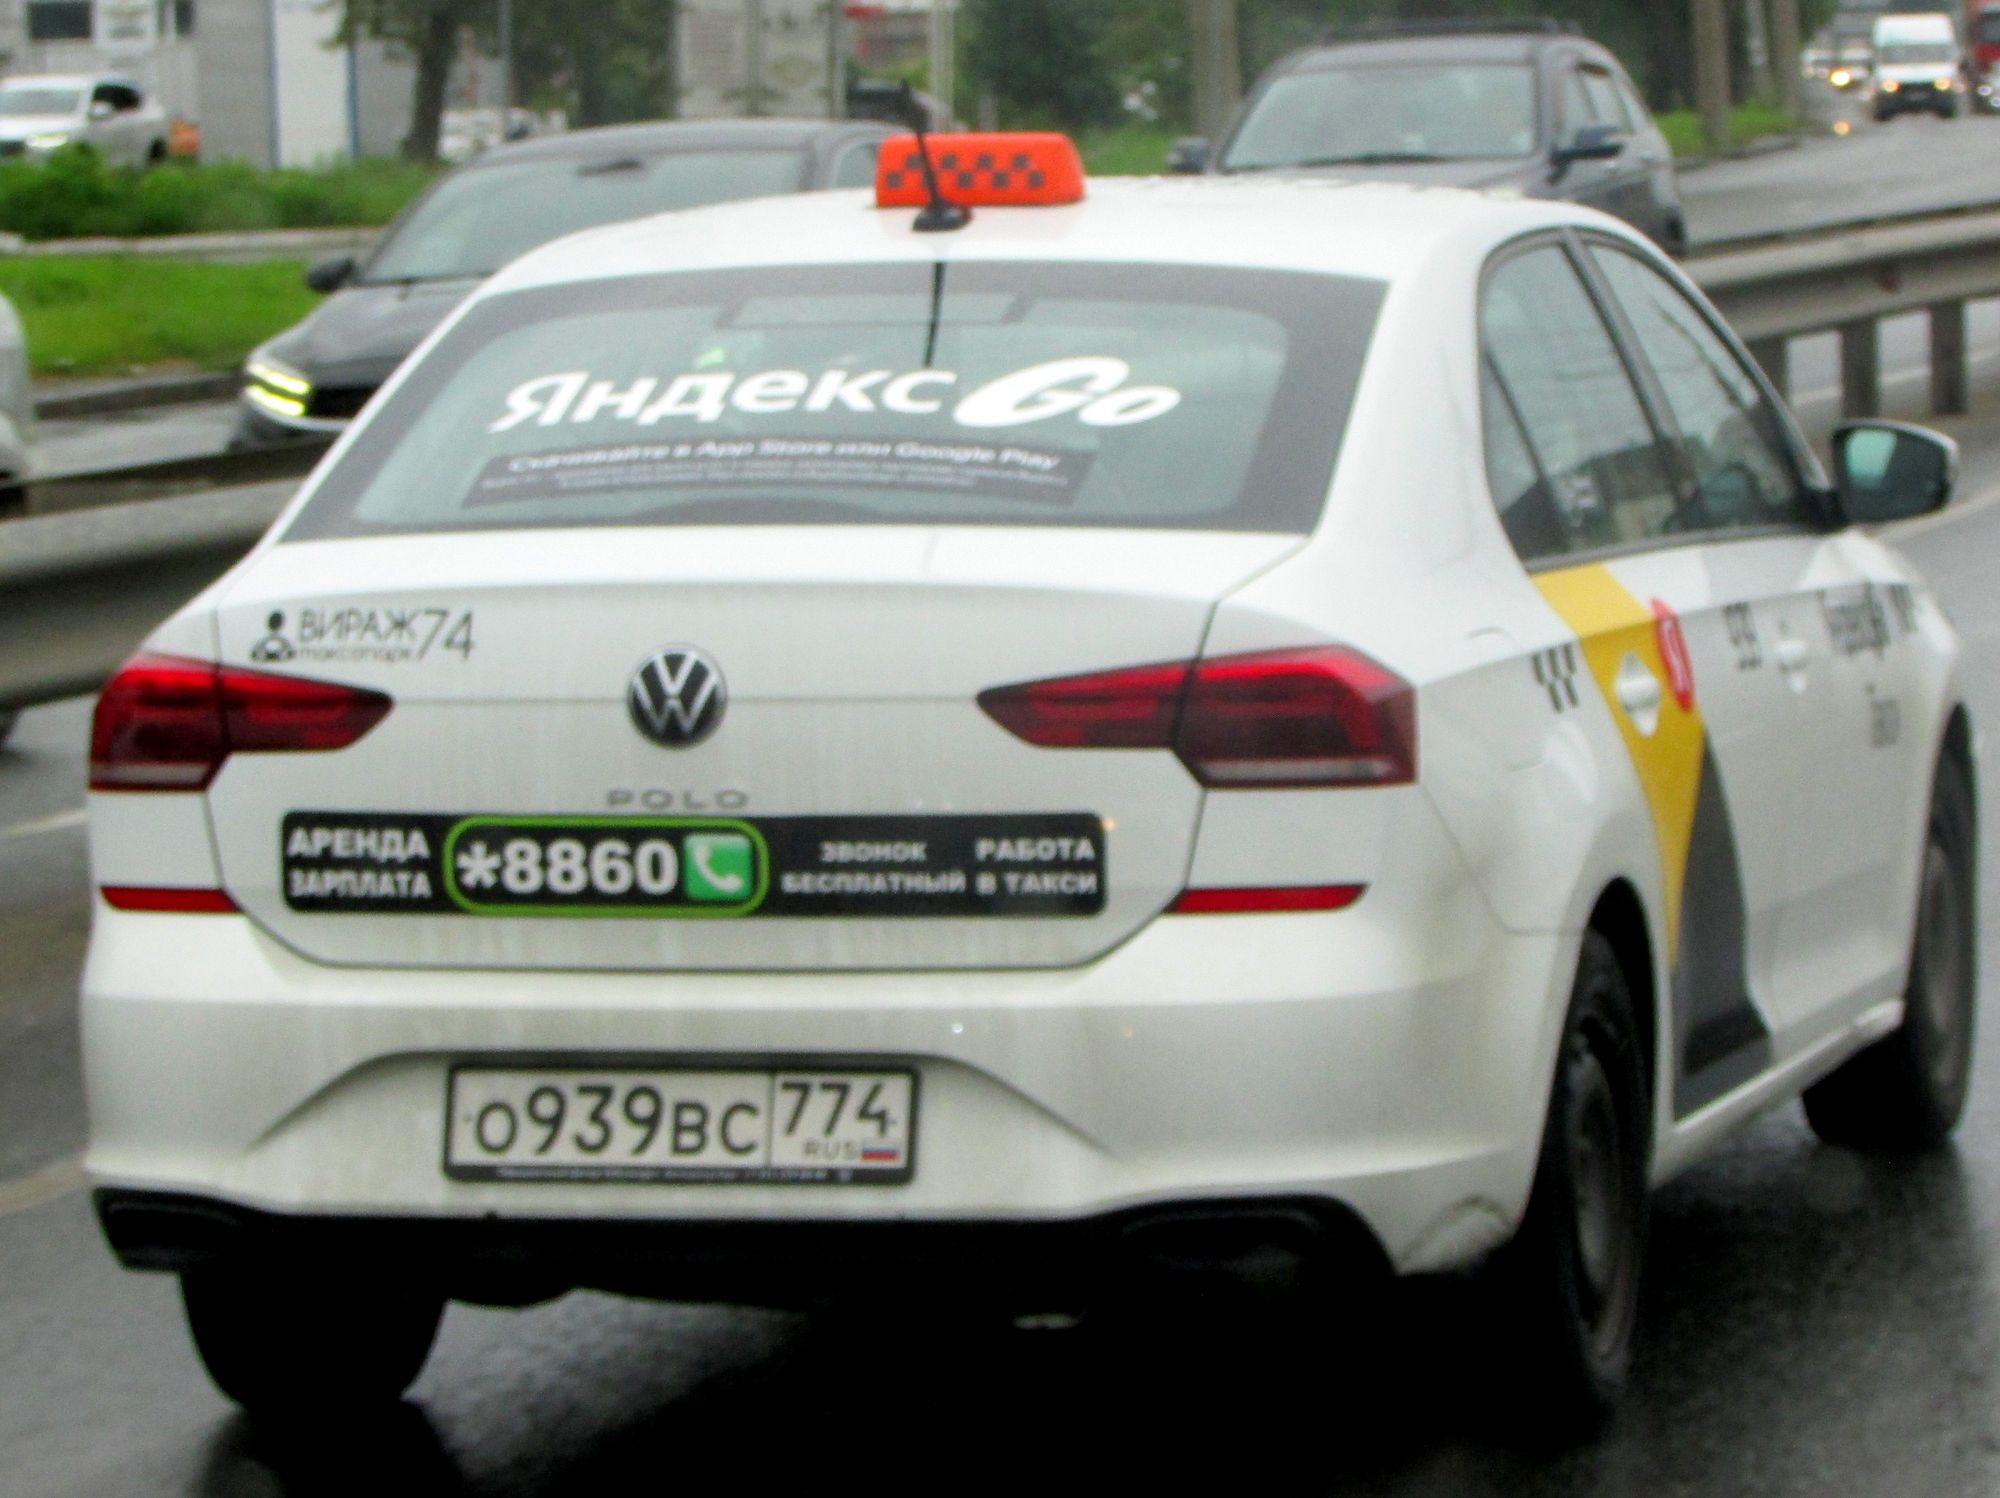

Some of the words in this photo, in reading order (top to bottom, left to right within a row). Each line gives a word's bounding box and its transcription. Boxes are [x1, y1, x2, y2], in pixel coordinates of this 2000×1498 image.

[489, 368, 957, 434] Яндекс
[951, 355, 1182, 428] Go
[695, 439, 755, 460] App
[758, 439, 834, 457] Store
[894, 441, 997, 464] Google
[606, 788, 749, 810] POLO
[286, 826, 430, 862] АРЕНДА
[820, 840, 928, 863] ЗВОНОК
[974, 837, 1096, 862] РАБОТА
[289, 868, 432, 899] ЗАРПЛАТА
[780, 869, 967, 894] БЕСПЛАТНЫЙ
[975, 872, 997, 896] В
[1003, 872, 1098, 895] ТАКСИ
[780, 1079, 889, 1137] 774
[803, 1140, 857, 1160] RUS
